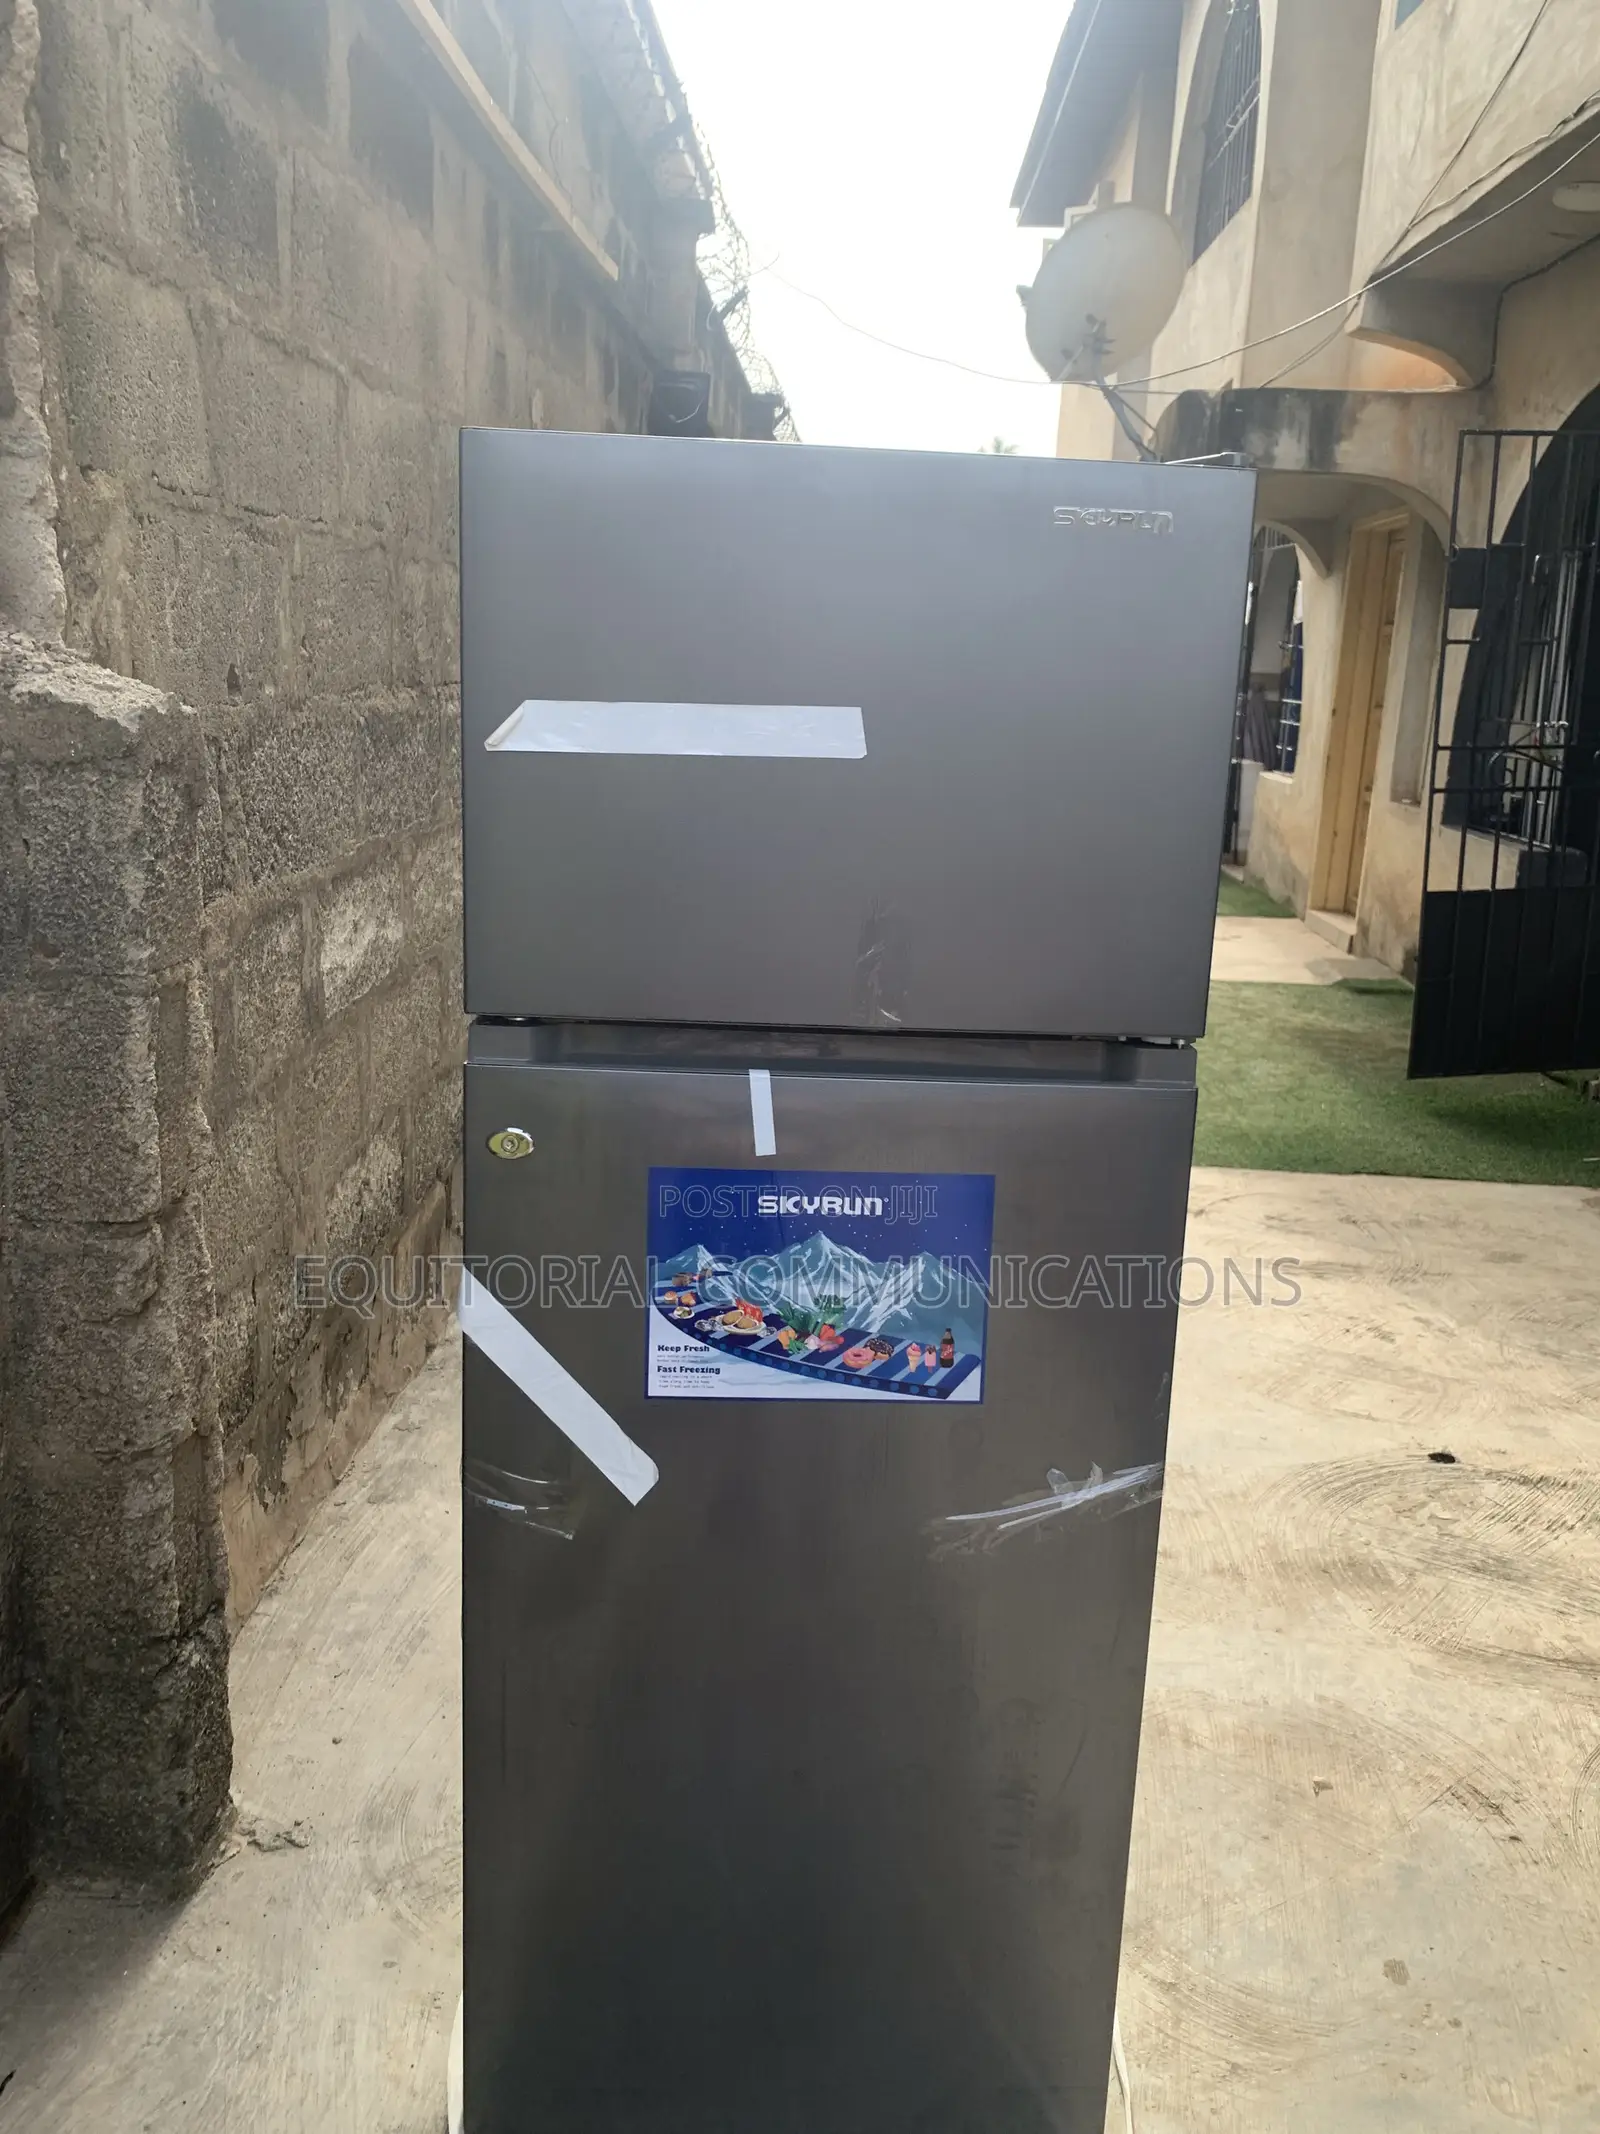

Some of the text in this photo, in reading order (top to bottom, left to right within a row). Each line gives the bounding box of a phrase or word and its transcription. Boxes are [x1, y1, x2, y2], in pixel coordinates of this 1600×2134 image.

[757, 1195, 883, 1216] SKYRUN
[657, 1344, 681, 1353] Keep
[657, 1365, 721, 1374] Fast Freezing
